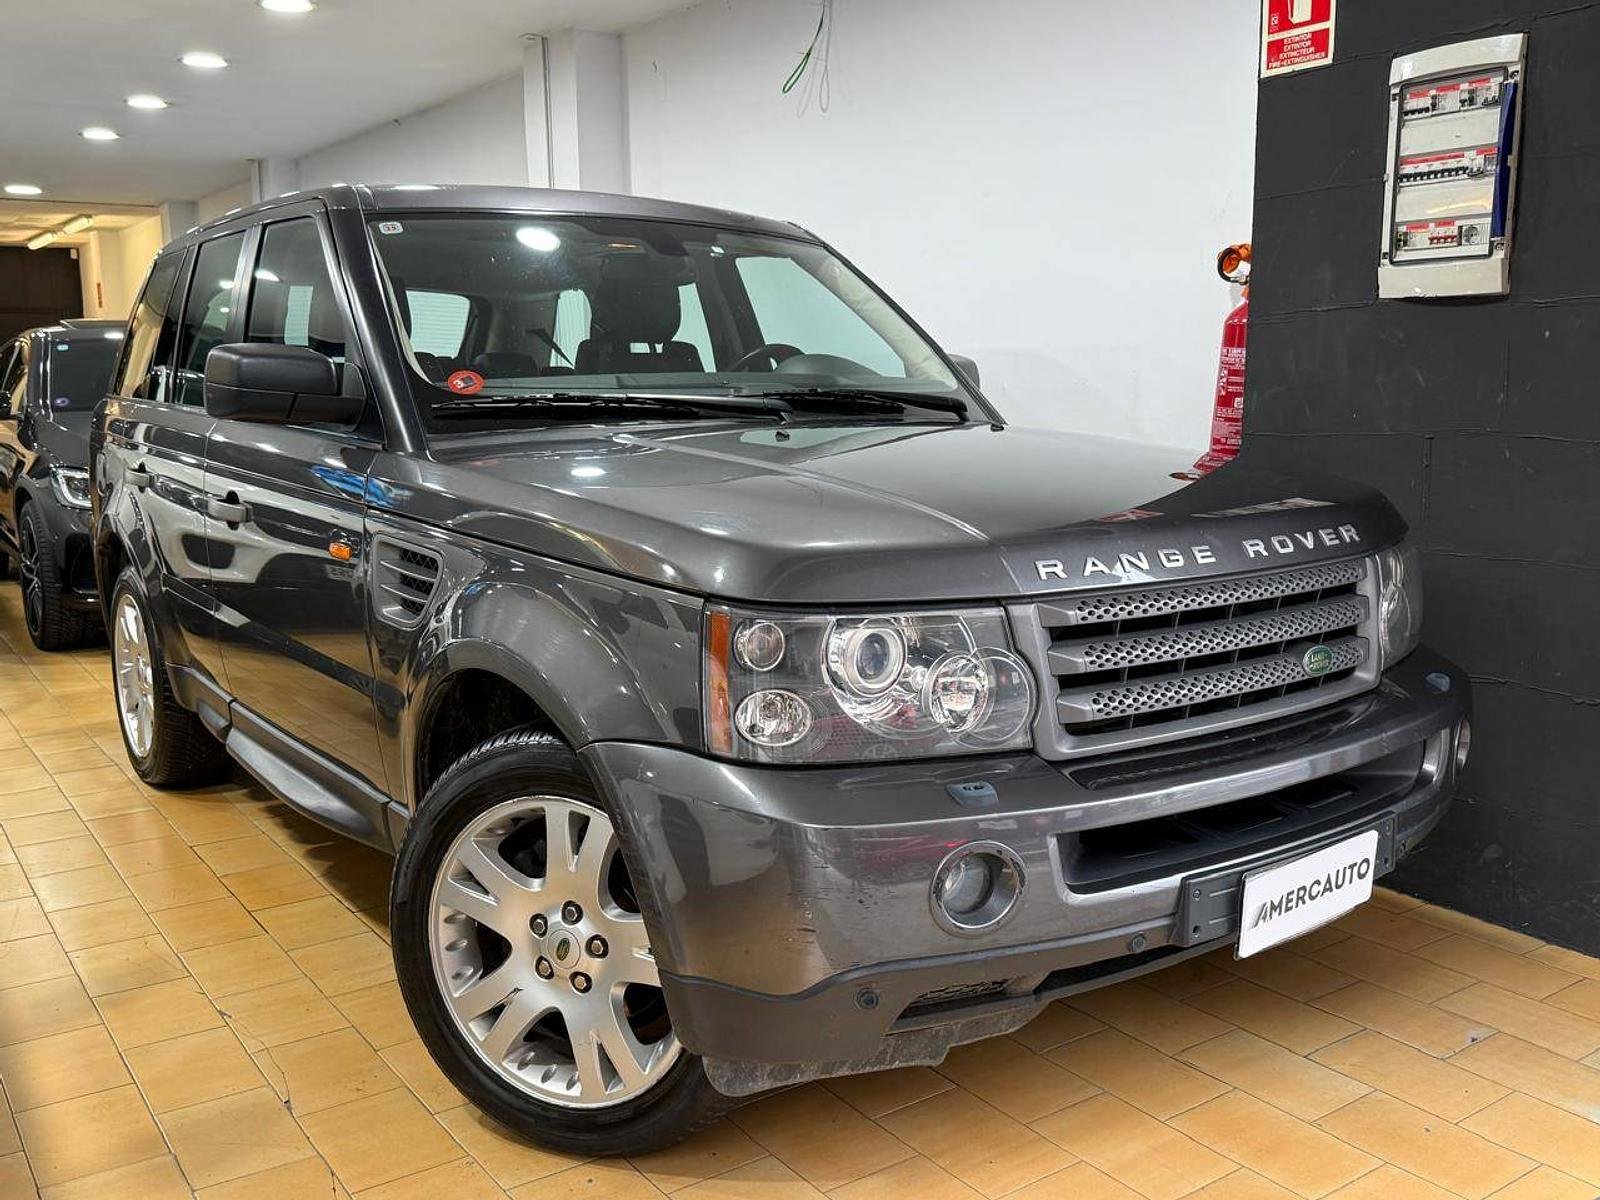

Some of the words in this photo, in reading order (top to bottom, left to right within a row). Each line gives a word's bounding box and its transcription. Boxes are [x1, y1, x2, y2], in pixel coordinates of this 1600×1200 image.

[1033, 545, 1216, 580] RANGE
[1242, 523, 1361, 559] ROVER
[1254, 858, 1371, 928] AMERCAUTO
